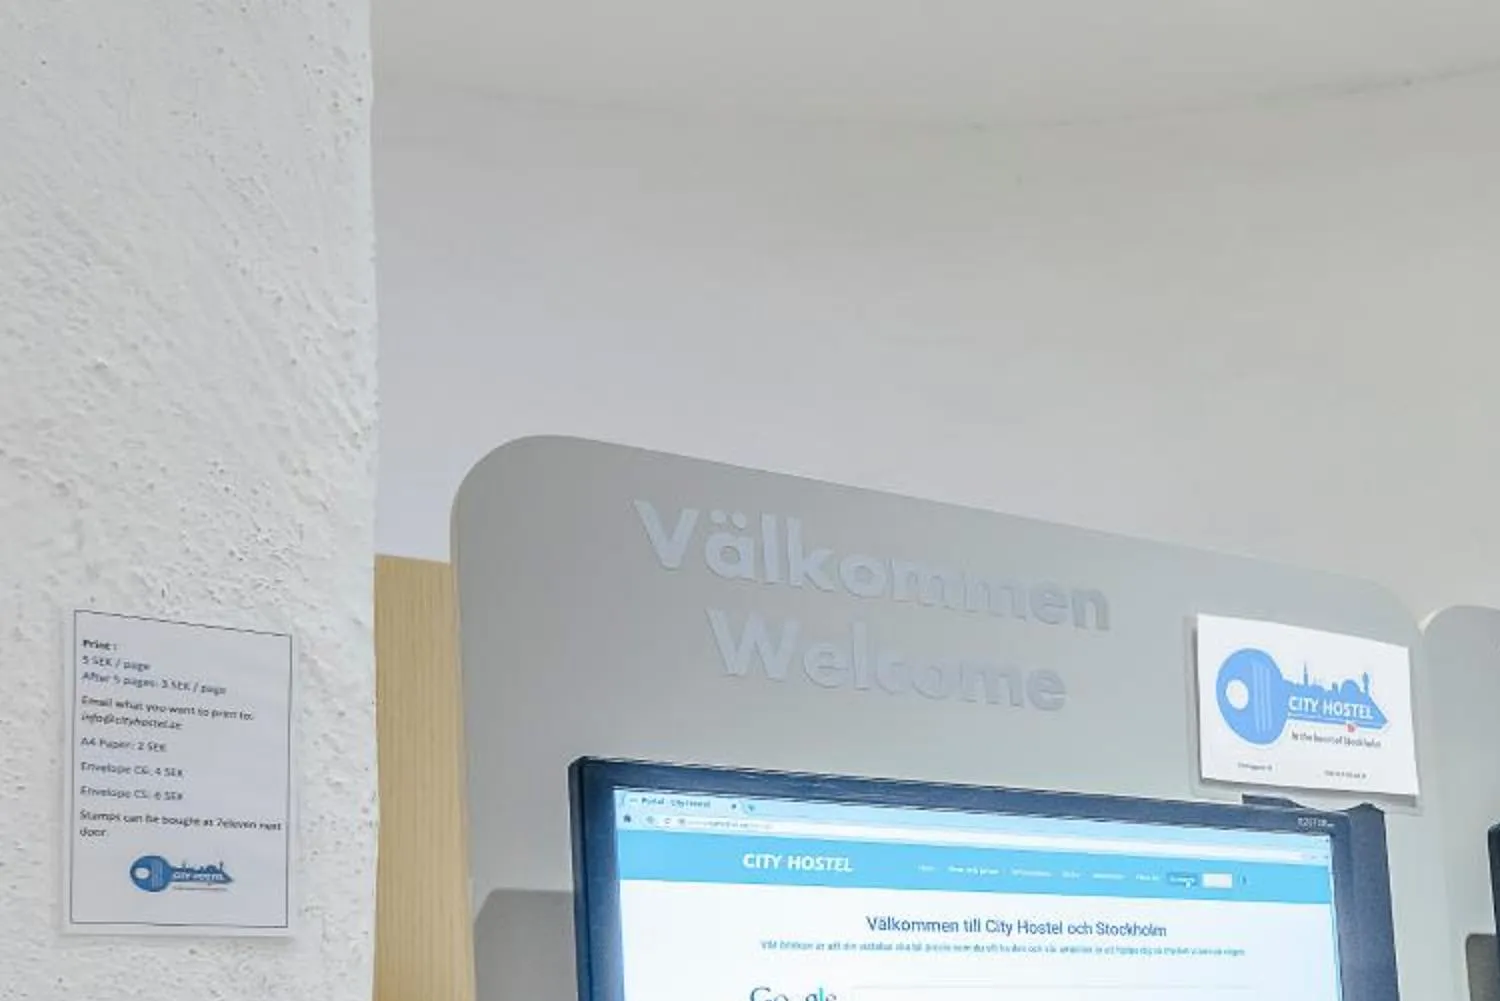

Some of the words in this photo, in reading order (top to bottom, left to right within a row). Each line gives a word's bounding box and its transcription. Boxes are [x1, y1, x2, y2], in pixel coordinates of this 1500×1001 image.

[633, 499, 1111, 631] Välkommen
[705, 608, 1066, 711] Welcome
[115, 700, 143, 710] what
[145, 703, 166, 713] you
[1288, 696, 1319, 712] CITY
[1323, 701, 1374, 720] HOSTEL
[743, 853, 782, 870] CITY
[788, 855, 853, 873] HOSTEL
[866, 916, 959, 933] Välkommen
[963, 918, 981, 933] till
[985, 919, 1012, 936] City
[1017, 920, 1063, 935] Hostel
[1067, 921, 1093, 935] och
[1095, 922, 1166, 937] Stockholm
